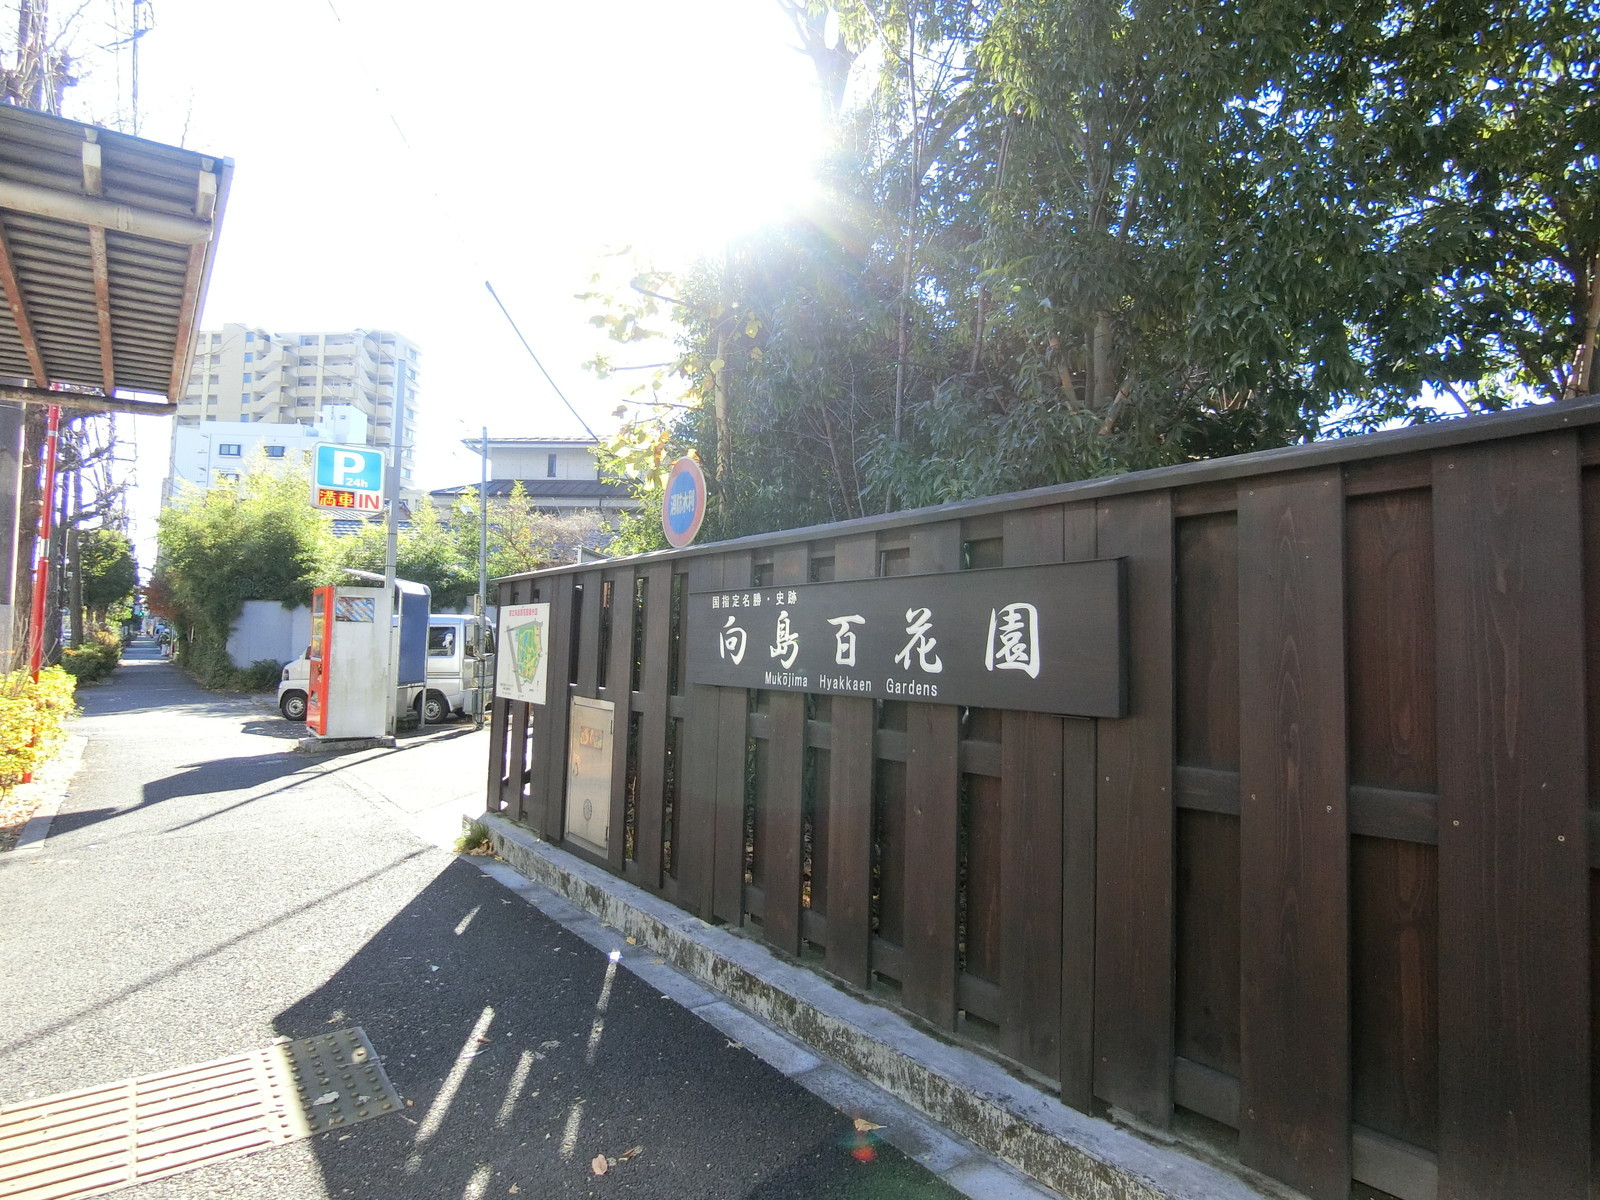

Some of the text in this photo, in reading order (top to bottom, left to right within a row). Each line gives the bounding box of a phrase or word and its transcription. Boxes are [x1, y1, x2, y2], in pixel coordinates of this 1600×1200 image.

[333, 450, 366, 485] P
[345, 477, 369, 488] 24h
[319, 489, 354, 508] 満車
[358, 494, 380, 510] IN
[712, 590, 798, 609] 国指定名勝・史跡
[719, 602, 1040, 679] 向島百花園
[819, 674, 872, 692] Hyakkaen
[886, 678, 938, 697] Gardens
